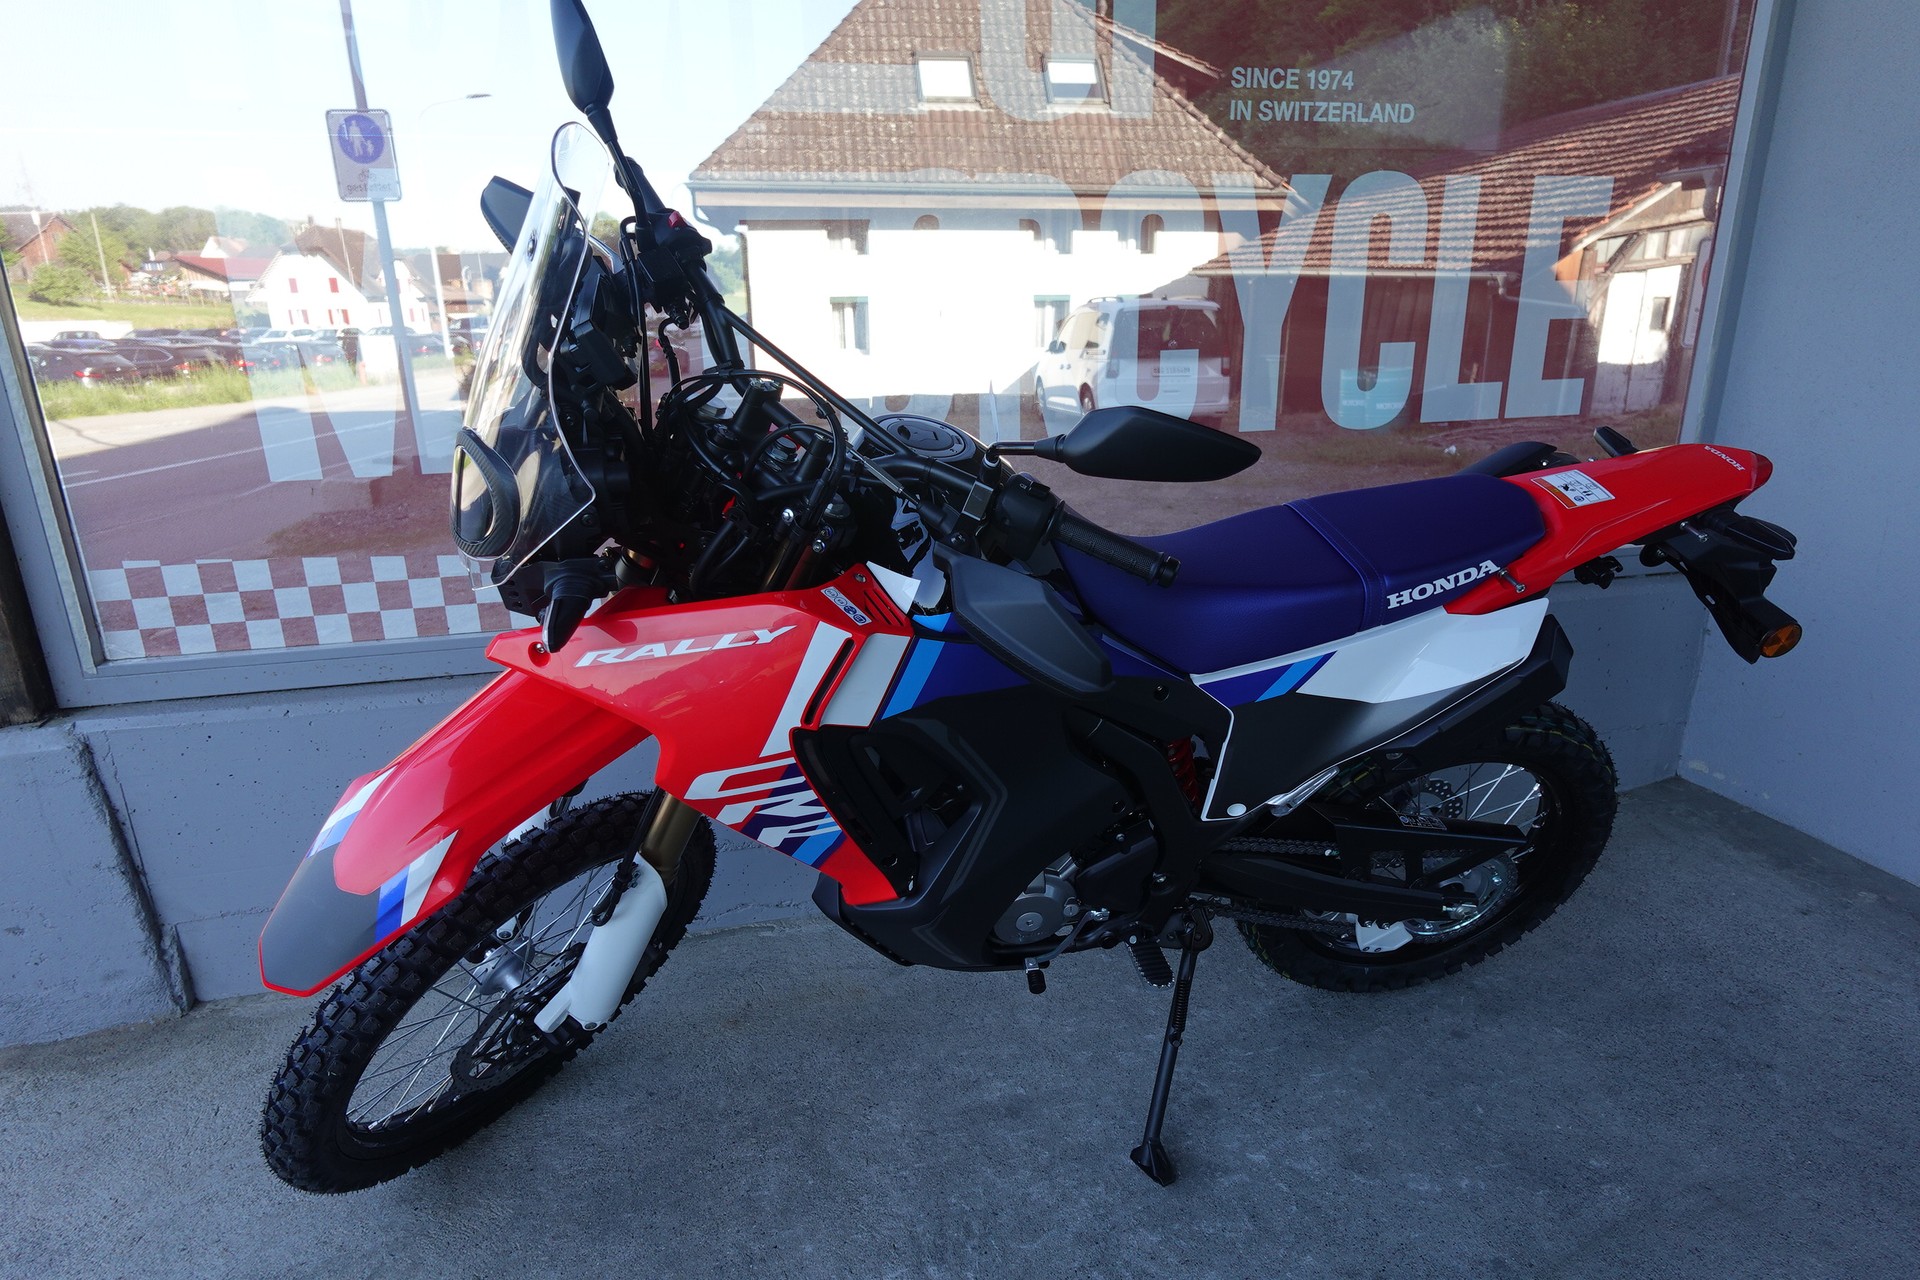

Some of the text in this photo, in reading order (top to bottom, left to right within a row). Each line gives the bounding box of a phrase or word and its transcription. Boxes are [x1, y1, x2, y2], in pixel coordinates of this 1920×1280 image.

[1231, 66, 1355, 91] SINCE 1974
[1229, 100, 1416, 124] IN SWITZERLAND
[208, 168, 1616, 483] MORCYCLE
[1704, 445, 1745, 471] HONDA
[1386, 560, 1500, 609] HONDA
[575, 625, 797, 668] RALLY
